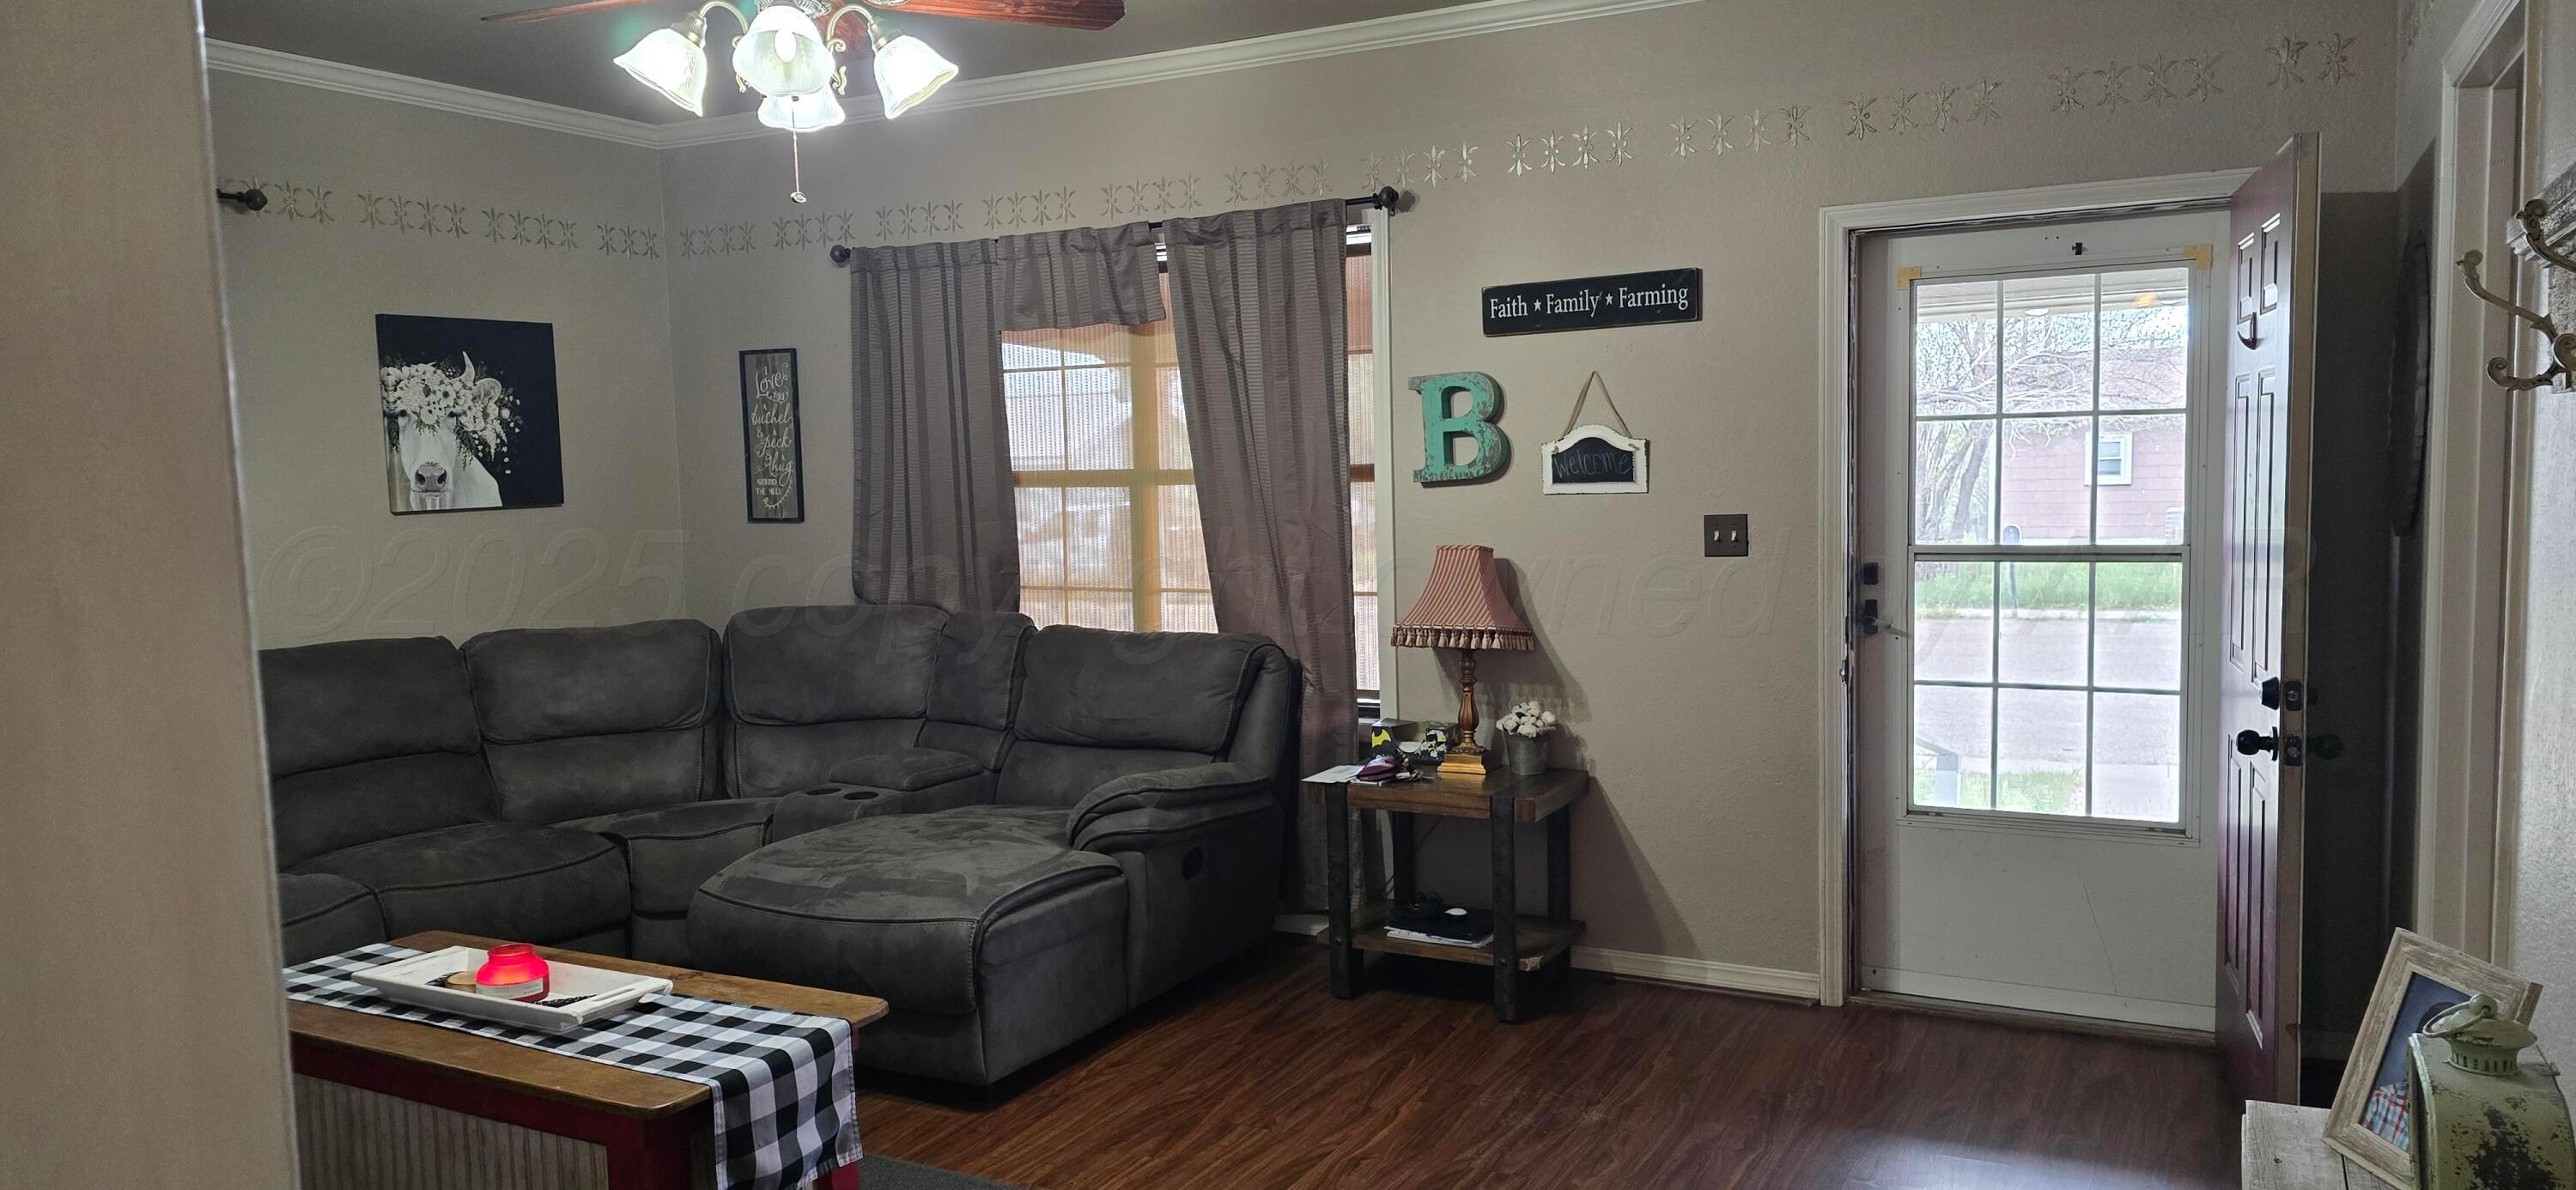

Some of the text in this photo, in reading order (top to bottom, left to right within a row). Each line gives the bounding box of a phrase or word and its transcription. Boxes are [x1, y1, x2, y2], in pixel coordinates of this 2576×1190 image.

[1490, 282, 1689, 319] Faith Family Farming
[1408, 371, 1511, 488] B
